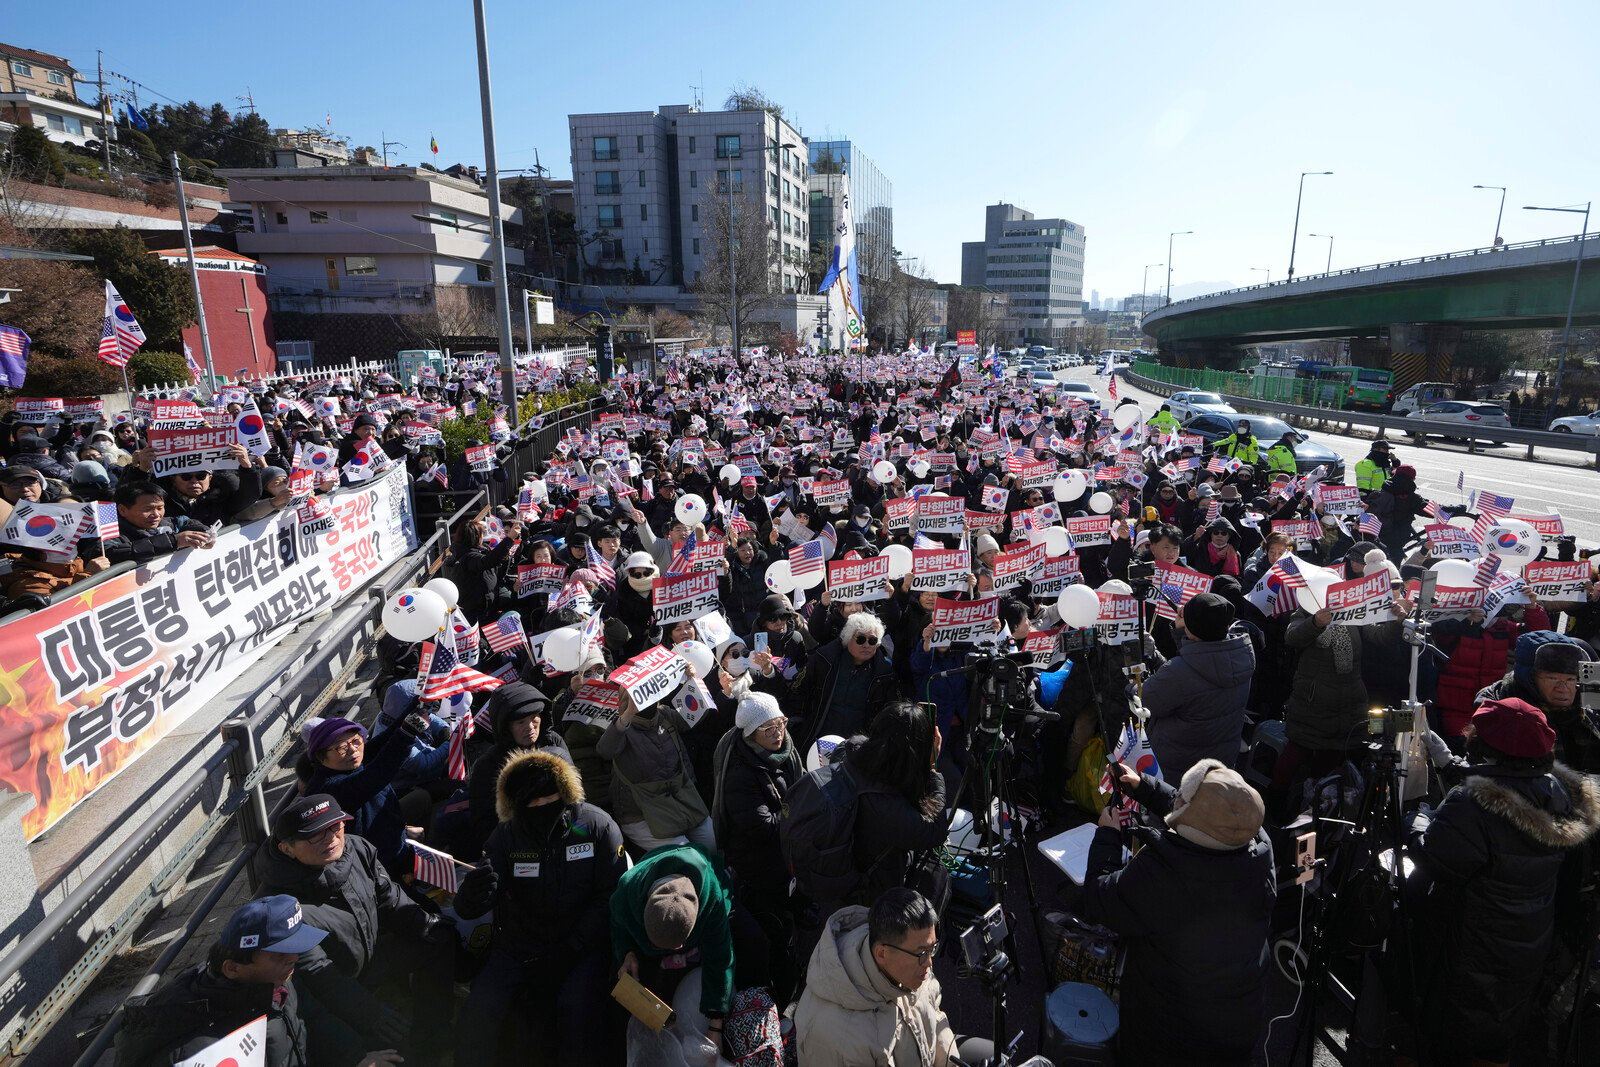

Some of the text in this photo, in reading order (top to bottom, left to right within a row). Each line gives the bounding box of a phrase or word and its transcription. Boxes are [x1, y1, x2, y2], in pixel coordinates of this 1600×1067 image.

[152, 431, 237, 453] 탄핵반대
[154, 452, 203, 475] 이재명
[1023, 462, 1058, 478] 탄핵반대
[814, 480, 850, 495] 탄핵반대
[1322, 489, 1360, 501] 탄핵반대
[920, 498, 964, 513] 탄핵반대
[919, 516, 947, 529] 이재명
[1070, 519, 1109, 533] 탄핵반대
[1093, 532, 1110, 541] 구속
[914, 553, 969, 572] 탄핵반대
[995, 545, 1046, 574] 탄핵반대
[519, 565, 567, 582] 탄핵반대
[831, 560, 889, 585] 탄핵반대
[912, 570, 969, 588] 이재명 구속
[994, 561, 1046, 590] 이재명 구속
[1528, 565, 1590, 581] 탄핵반대
[655, 573, 718, 605] 탄핵반대
[830, 577, 888, 600] 이재명 구속
[1032, 580, 1059, 596] 이재명
[1329, 576, 1391, 608] 탄핵반대
[654, 595, 719, 622] 이재명 구속
[935, 600, 999, 625] 탄핵반대
[40, 579, 189, 699] 대통령
[932, 627, 971, 644] 이재명
[63, 623, 236, 771] 부정선거
[329, 530, 384, 592] 중국인?
[615, 646, 675, 687] 탄핵반대
[632, 675, 668, 709] 이재명
[315, 800, 330, 812] ARMY
